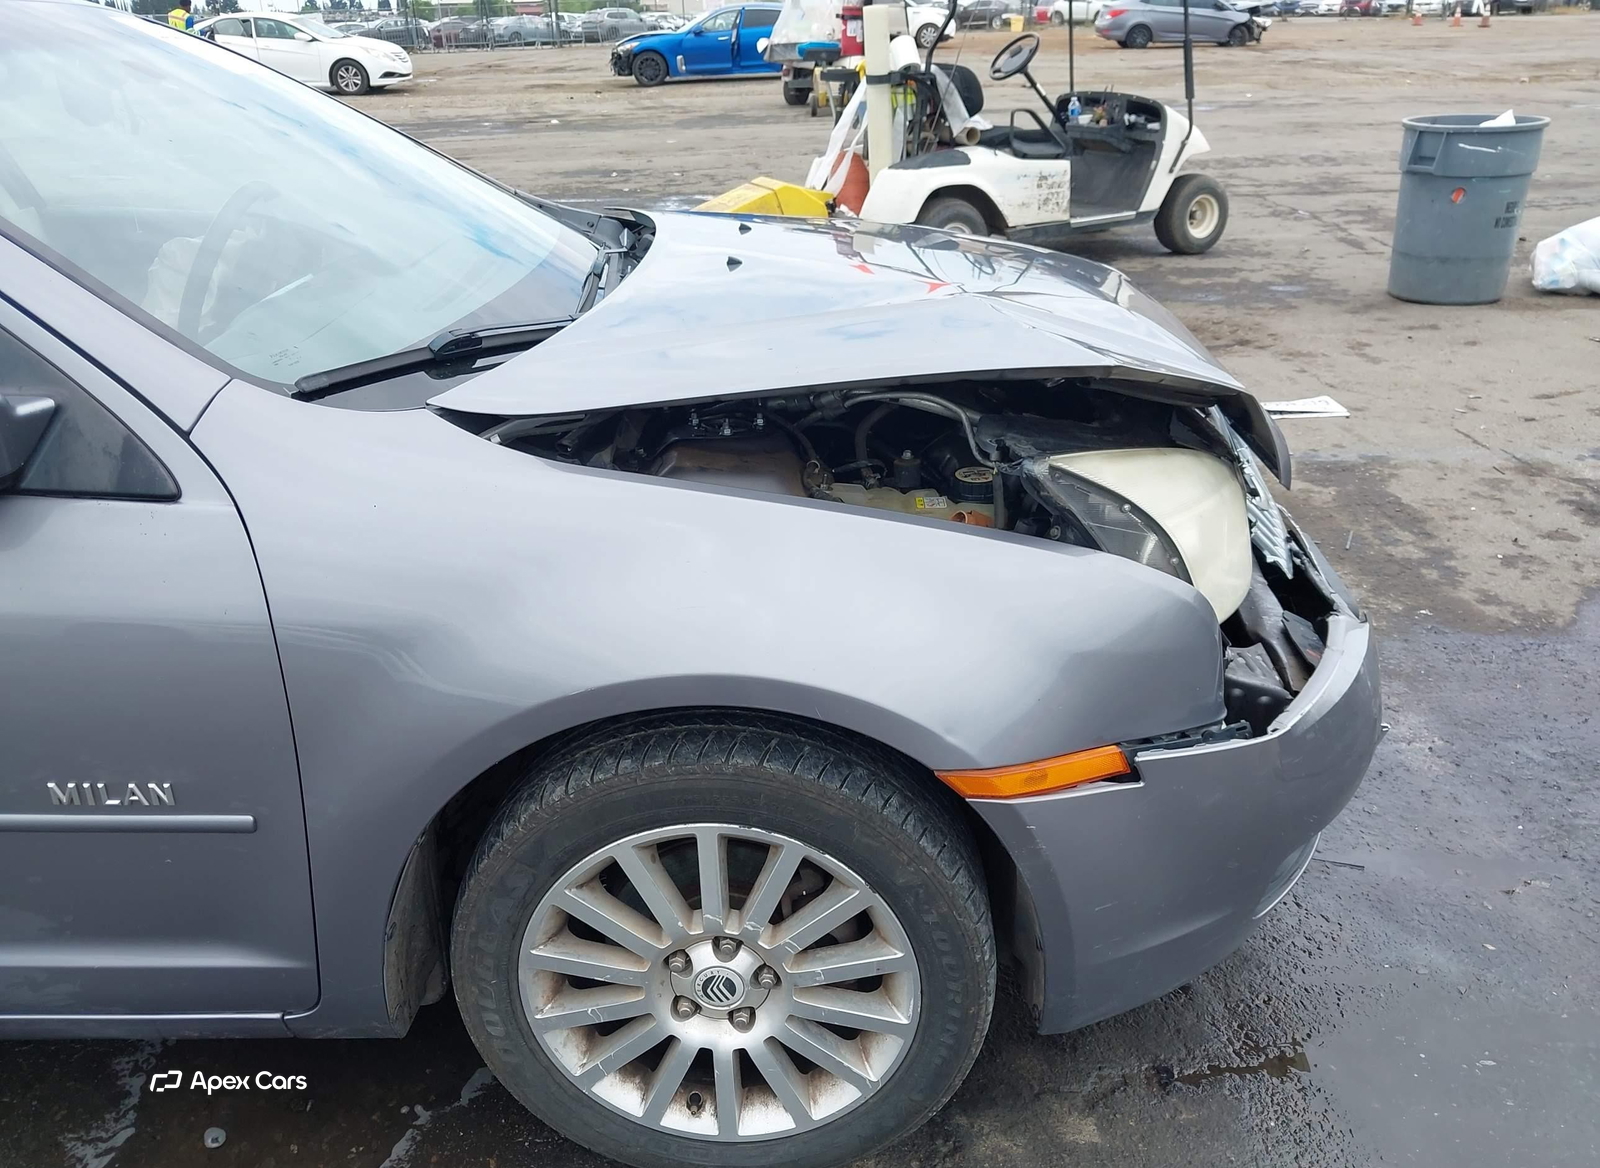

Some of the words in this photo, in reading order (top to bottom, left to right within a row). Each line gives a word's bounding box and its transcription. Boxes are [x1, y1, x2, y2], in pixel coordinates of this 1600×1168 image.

[46, 781, 176, 806] MILAN
[697, 970, 721, 999] MERCURY
[919, 907, 963, 1067] TOURING
